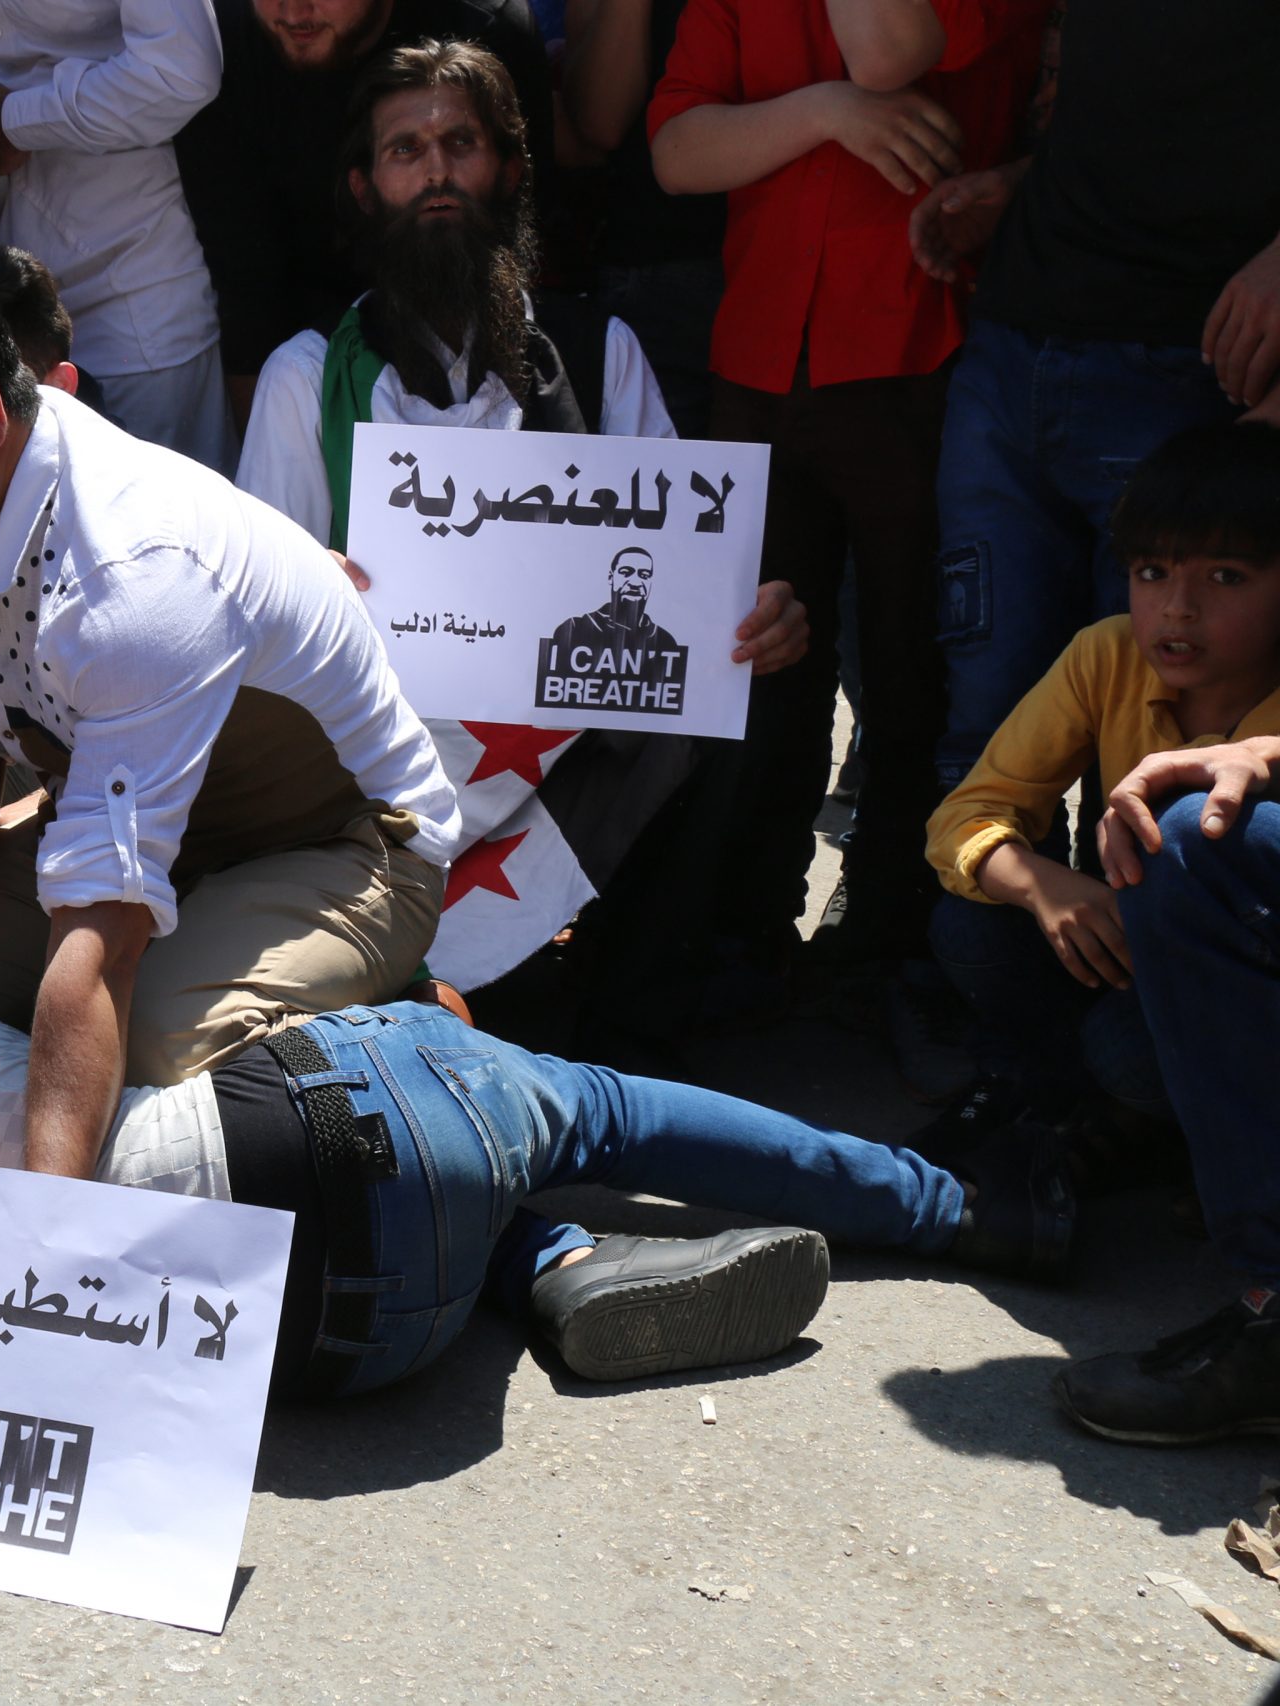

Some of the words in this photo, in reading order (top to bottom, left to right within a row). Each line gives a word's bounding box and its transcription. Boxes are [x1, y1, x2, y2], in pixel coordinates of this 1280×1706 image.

[388, 451, 672, 537] للعنصرية
[690, 470, 736, 534] لا
[390, 611, 436, 639] ادلب
[443, 612, 506, 644] مدينة
[549, 644, 558, 671] I
[570, 645, 681, 678] CAN'T
[543, 675, 681, 709] BREATHE
[193, 1294, 240, 1361] لا
